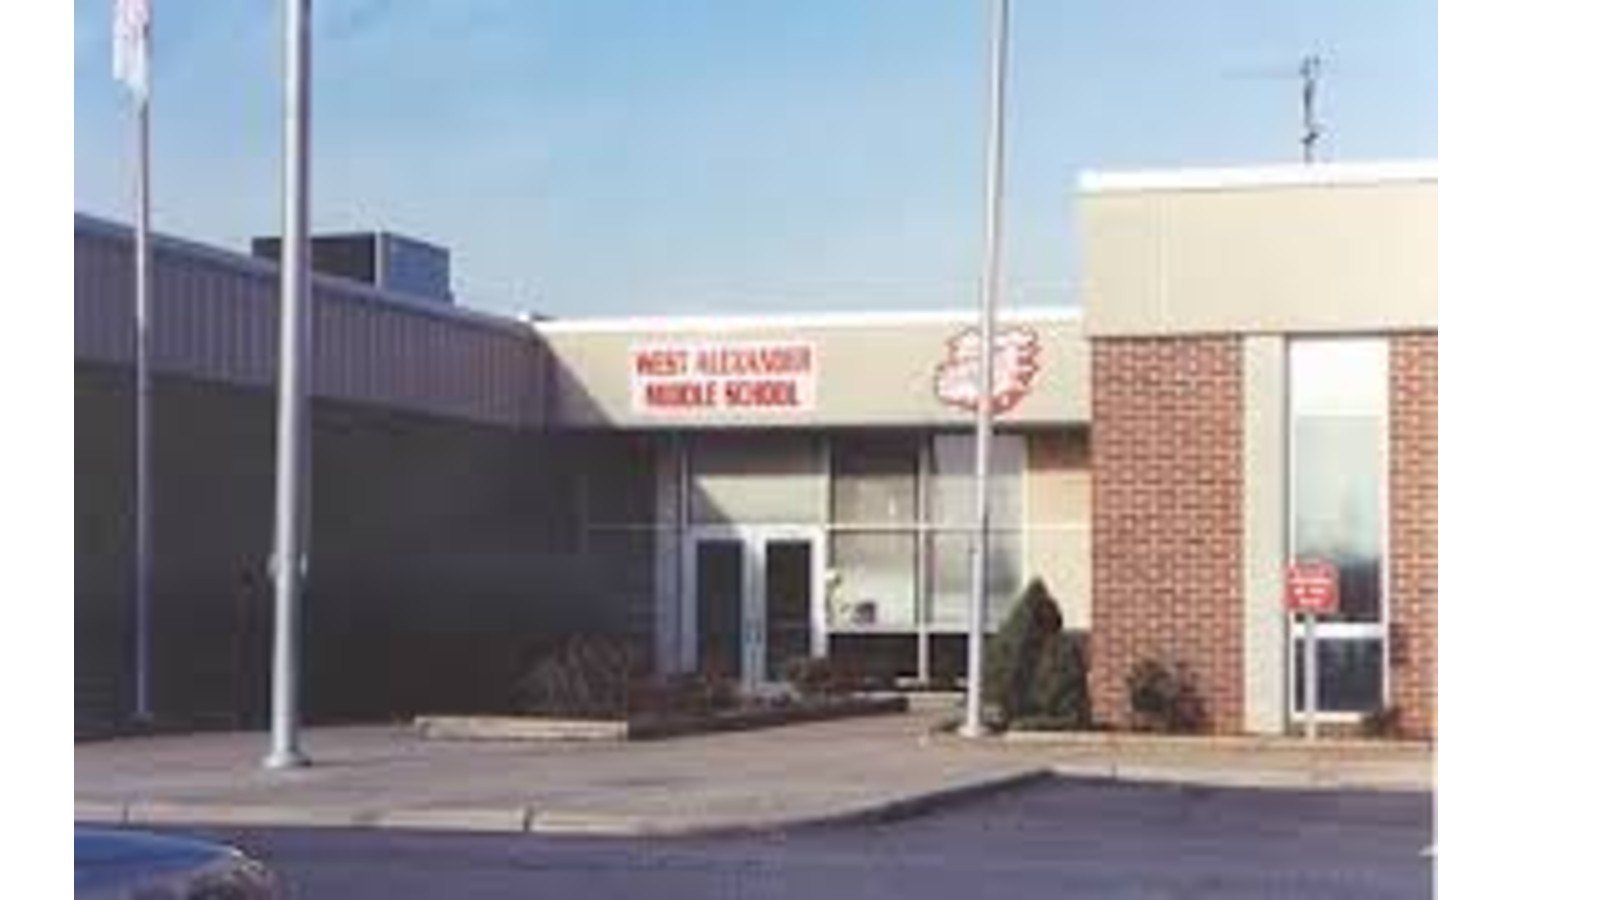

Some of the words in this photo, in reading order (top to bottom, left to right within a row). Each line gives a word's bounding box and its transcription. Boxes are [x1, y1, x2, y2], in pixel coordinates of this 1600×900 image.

[636, 350, 688, 375] WEST
[697, 347, 812, 375] ALEXANDER
[646, 380, 717, 406] MIDDLE
[725, 380, 799, 406] SCHOOL
